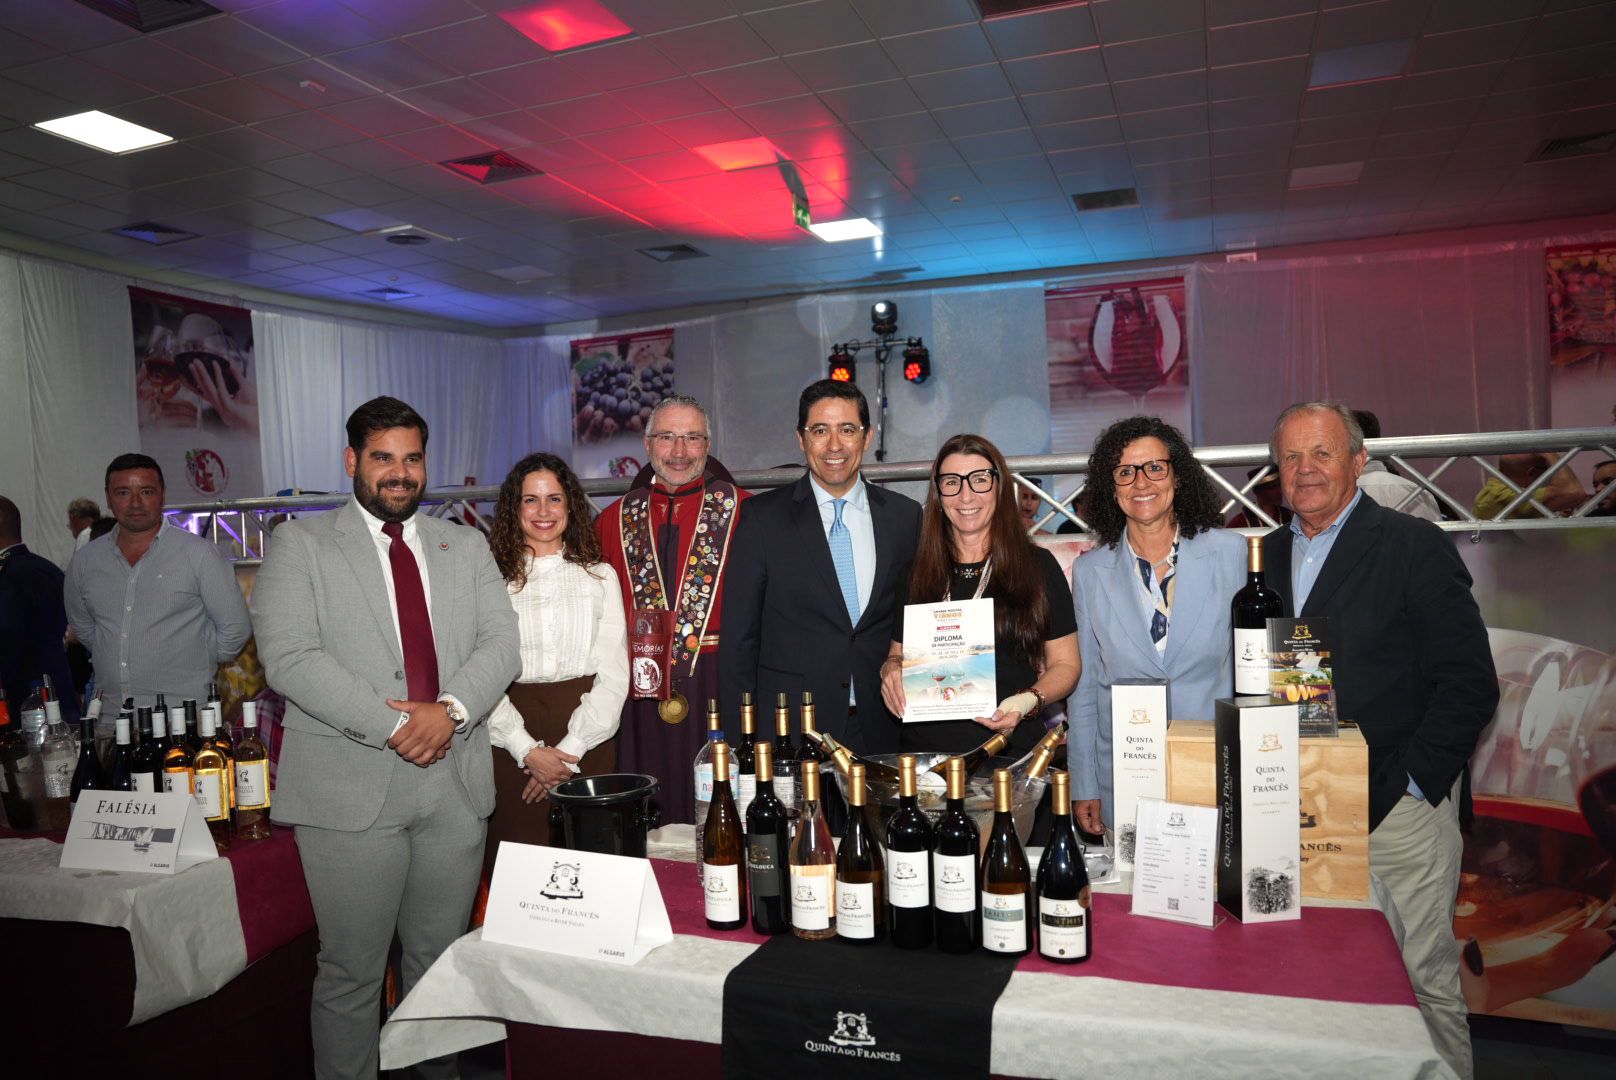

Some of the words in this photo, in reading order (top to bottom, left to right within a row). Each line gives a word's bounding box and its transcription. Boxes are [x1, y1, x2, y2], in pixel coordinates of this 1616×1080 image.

[933, 634, 962, 642] DIPLOMA
[1126, 735, 1154, 744] QUINTA
[1123, 752, 1157, 760] FRANCÊS
[1255, 766, 1285, 776] QUINTA
[1252, 783, 1289, 793] FRANCÊS
[96, 799, 157, 815] FALÉSIA
[1223, 802, 1230, 818] DO
[1223, 824, 1232, 868] QUINTA
[519, 900, 550, 913] QUINTA
[561, 907, 600, 919] FRANCÊS
[804, 1040, 844, 1055] QUINTA
[844, 1048, 856, 1056] DO
[857, 1048, 901, 1062] FRANCÊS
